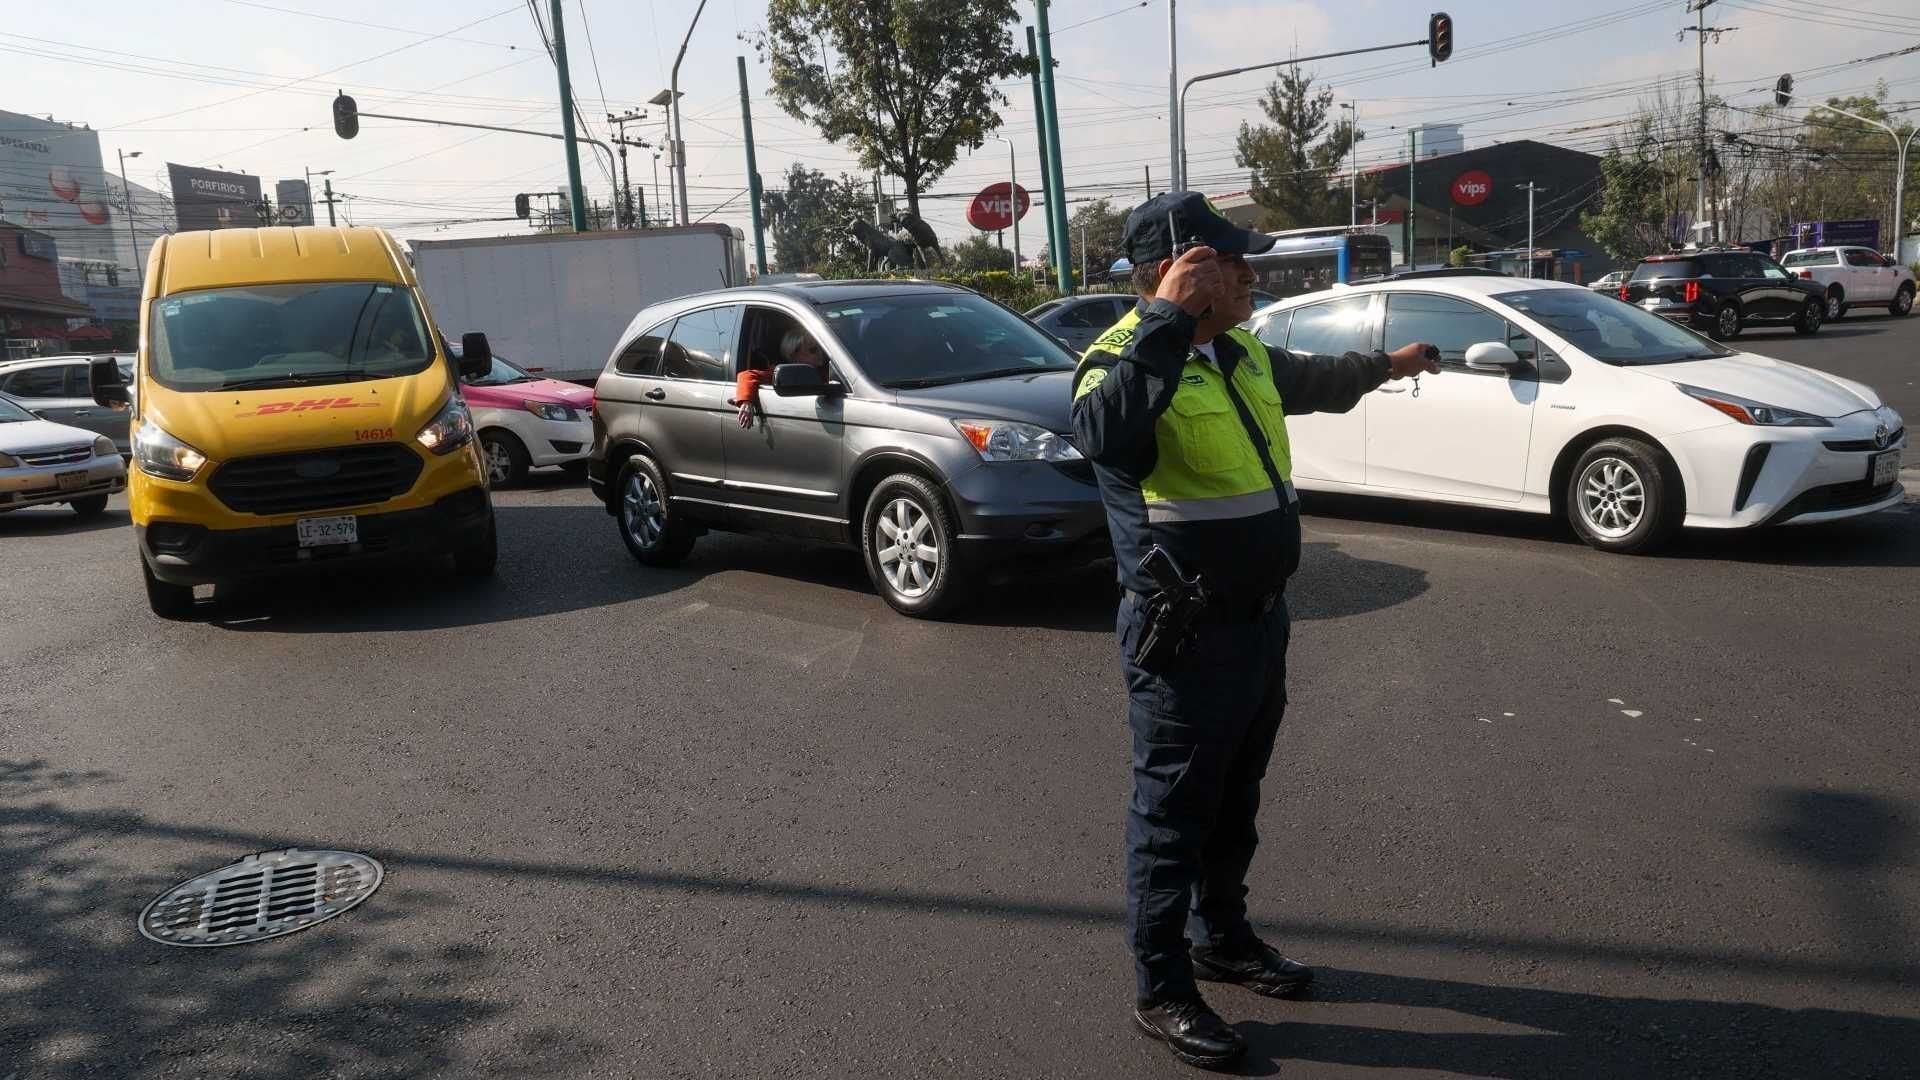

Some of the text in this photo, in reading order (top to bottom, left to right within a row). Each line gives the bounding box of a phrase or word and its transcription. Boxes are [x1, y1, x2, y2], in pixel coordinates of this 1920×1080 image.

[190, 178, 246, 194] PORFIRIO'S
[1459, 180, 1486, 197] vips
[256, 397, 360, 415] DHL
[354, 427, 394, 441] 14614
